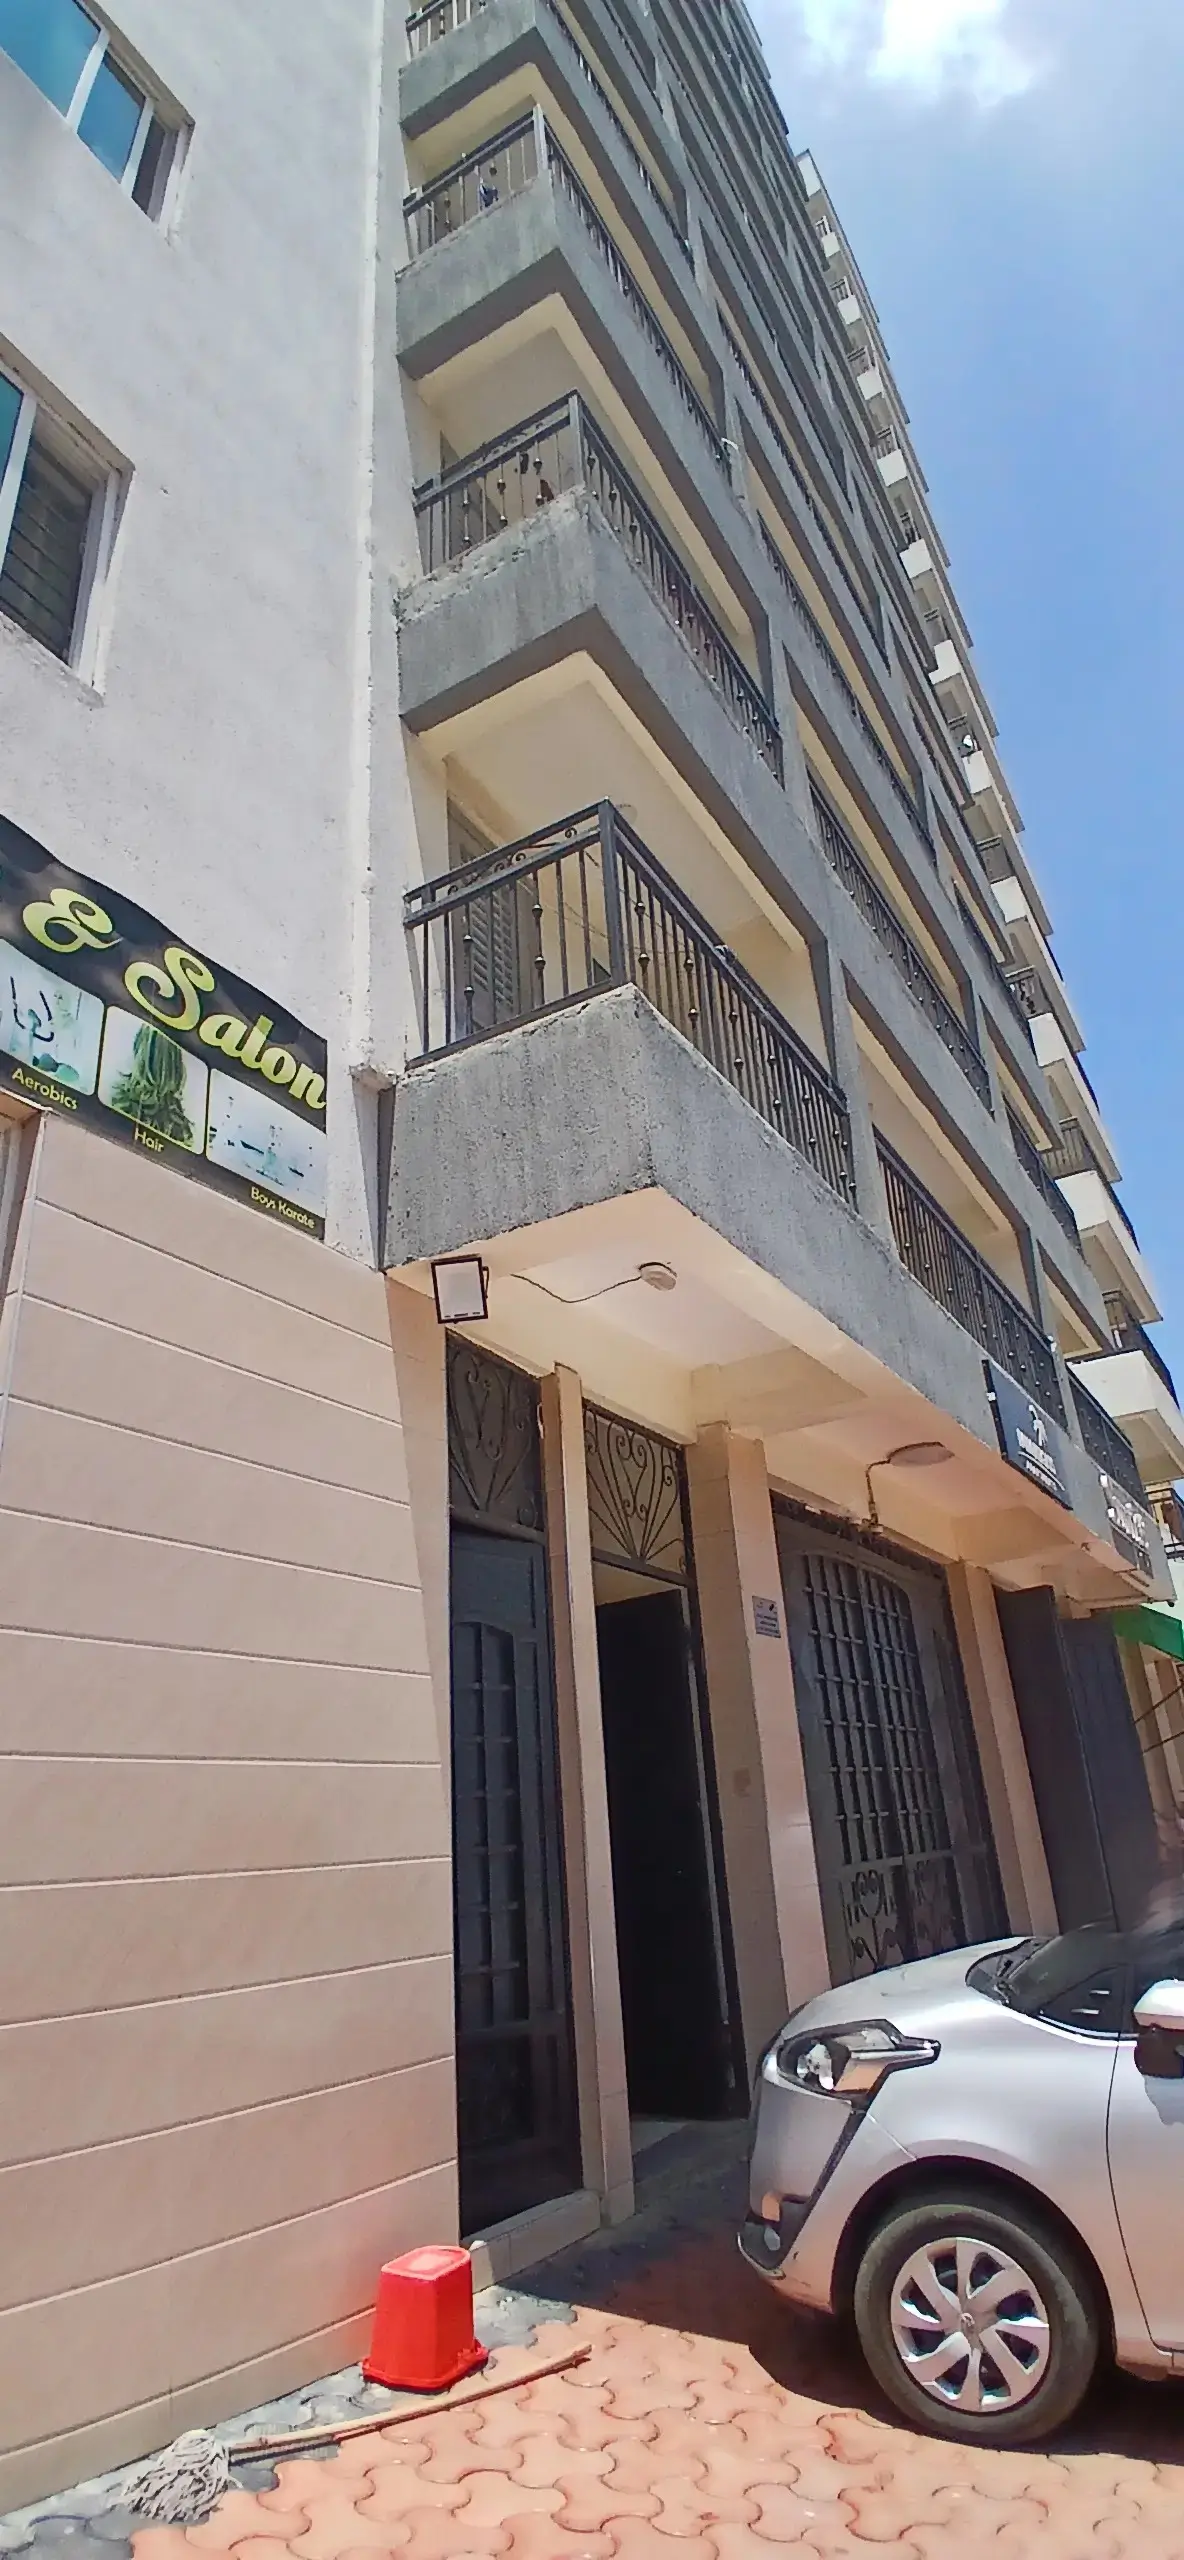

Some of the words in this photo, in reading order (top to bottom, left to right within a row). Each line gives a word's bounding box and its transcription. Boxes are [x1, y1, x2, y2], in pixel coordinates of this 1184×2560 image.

[22, 888, 123, 953] &
[124, 947, 326, 1109] Salon
[12, 1067, 77, 1110] Aerobics
[134, 1128, 164, 1153] Hair
[251, 1186, 276, 1209] Boys
[279, 1200, 315, 1229] Karate
